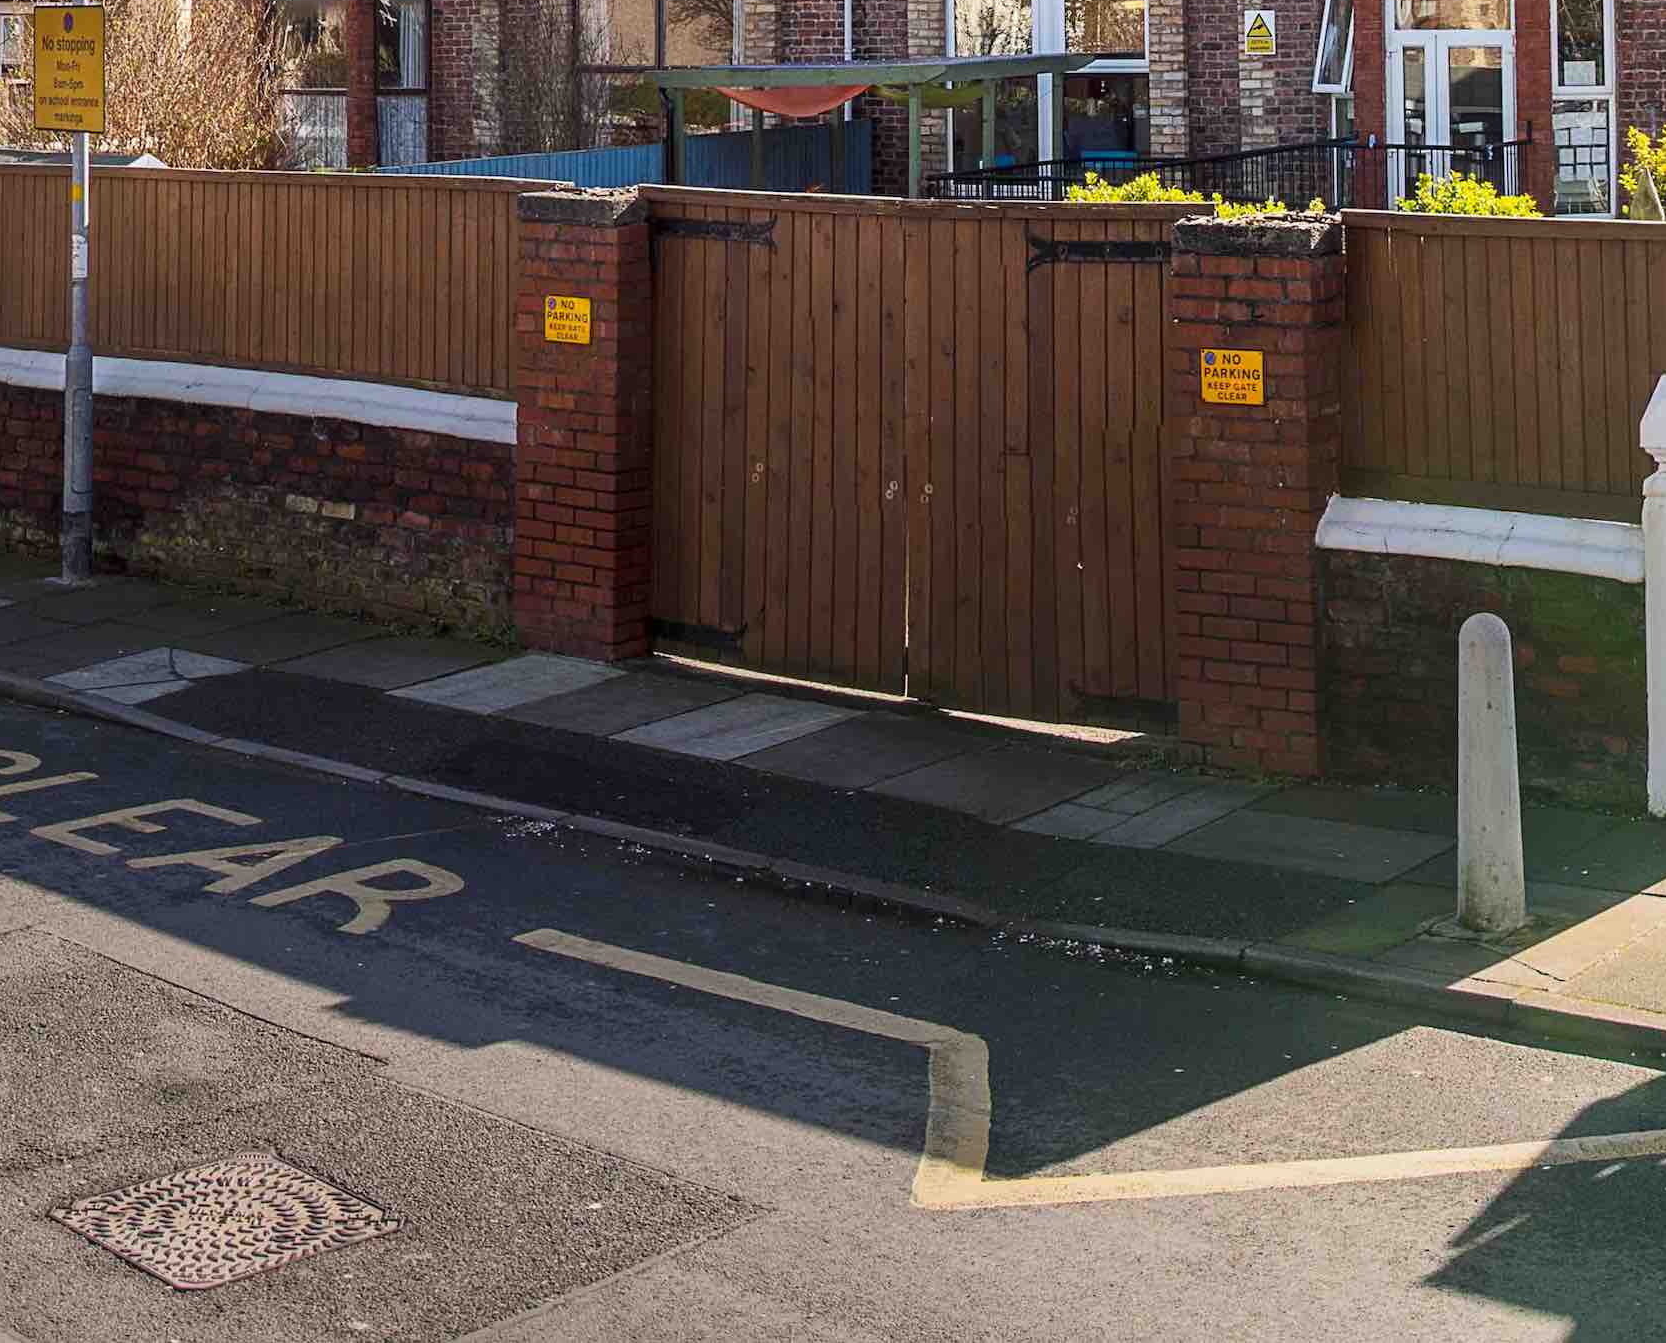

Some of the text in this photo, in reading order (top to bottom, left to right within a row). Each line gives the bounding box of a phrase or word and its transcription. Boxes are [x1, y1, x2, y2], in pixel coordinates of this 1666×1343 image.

[41, 35, 95, 56] No stopping
[561, 299, 574, 310] NO
[548, 311, 588, 323] PARKING
[1222, 353, 1241, 365] NO
[1204, 368, 1261, 381] PARKING
[1207, 381, 1258, 392] KEEP GATE
[1217, 392, 1247, 401] CLEAR
